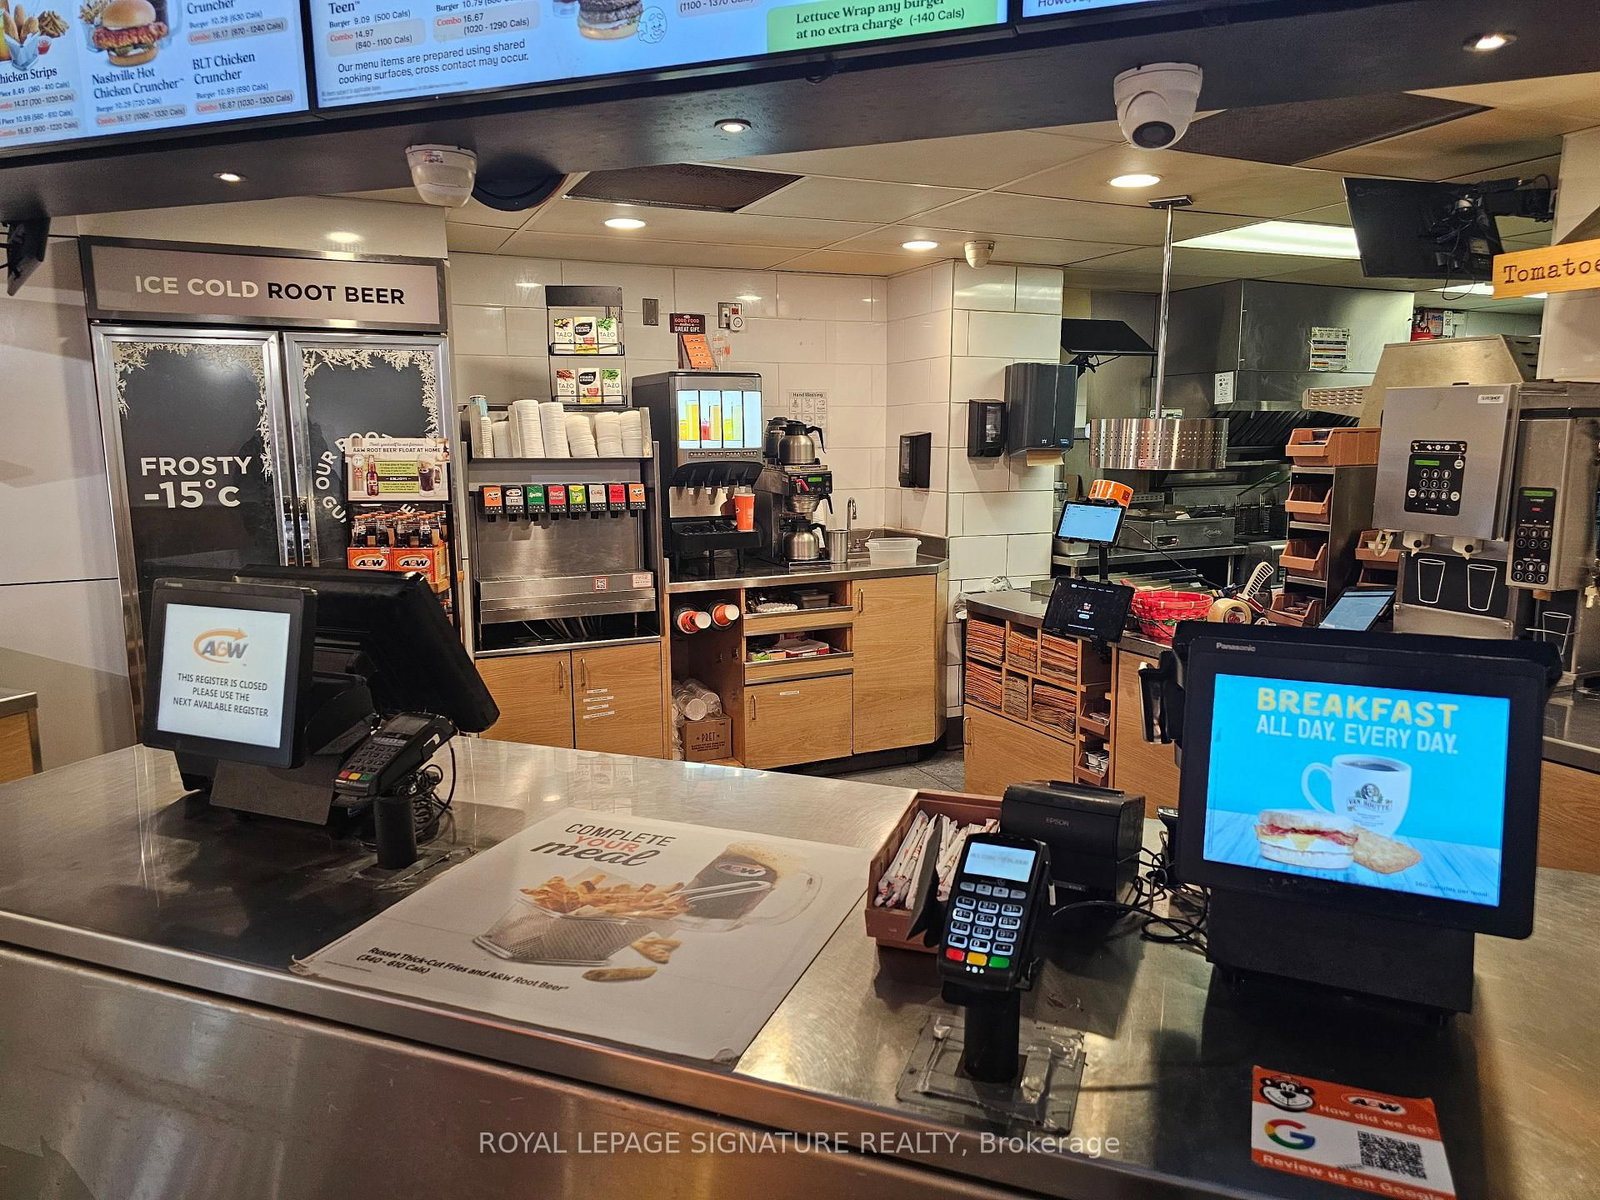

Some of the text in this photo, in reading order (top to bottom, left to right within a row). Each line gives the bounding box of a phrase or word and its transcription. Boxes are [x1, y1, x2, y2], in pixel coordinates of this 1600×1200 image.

[436, 4, 459, 12] Burger
[796, 10, 840, 24] Lettuce
[842, 6, 876, 18] Wrap
[878, 1, 902, 14] any
[329, 10, 411, 28] Burger 9.09 (500 Cals)
[436, 13, 484, 26] Combo 16.67
[464, 25, 484, 36] (1020
[490, 21, 508, 30] 1290
[510, 18, 530, 28] Cals)
[796, 8, 966, 40] at no extra charge (-140 Cals)
[330, 29, 374, 42] Combo 14.97
[377, 38, 392, 47] 1100
[394, 34, 412, 44] Cals)
[192, 53, 256, 70] BLT Chicken
[338, 38, 526, 73] Our menu items are prepared using shared
[30, 67, 58, 80] Strips
[92, 67, 155, 84] Nashville Hot
[194, 70, 242, 86] Cruncher
[338, 53, 529, 85] cooking surfaces, cross contact may occur.
[94, 86, 132, 100] Chicken
[136, 275, 405, 304] ICE COLD ROOT BEER
[140, 456, 252, 476] FROSTY
[316, 451, 338, 490] OUR
[144, 479, 241, 508] -15°C
[202, 640, 249, 658] A&W
[1216, 642, 1256, 652] Panasonic
[178, 672, 268, 692] THIS REGISTER IS CLOSED
[192, 687, 250, 702] PLEASE USE THE
[172, 697, 269, 717] NEXT AVAILABLE REGISTER
[1257, 687, 1459, 728] BREAKFAST
[1256, 714, 1459, 754] ALL DAY. EVERY DAY.
[564, 824, 677, 847] COMPLETE
[574, 836, 642, 852] YOUR
[529, 842, 660, 866] meal
[356, 954, 381, 964] (340
[388, 960, 406, 969] 610
[404, 964, 430, 974] Cals)
[368, 946, 538, 987] Russet Thick-Cut Fries and A&W Root
[1319, 1104, 1434, 1135] How did we do?
[1262, 1154, 1323, 1177] Review
[1328, 1170, 1347, 1182] us
[1351, 1176, 1374, 1188] on
